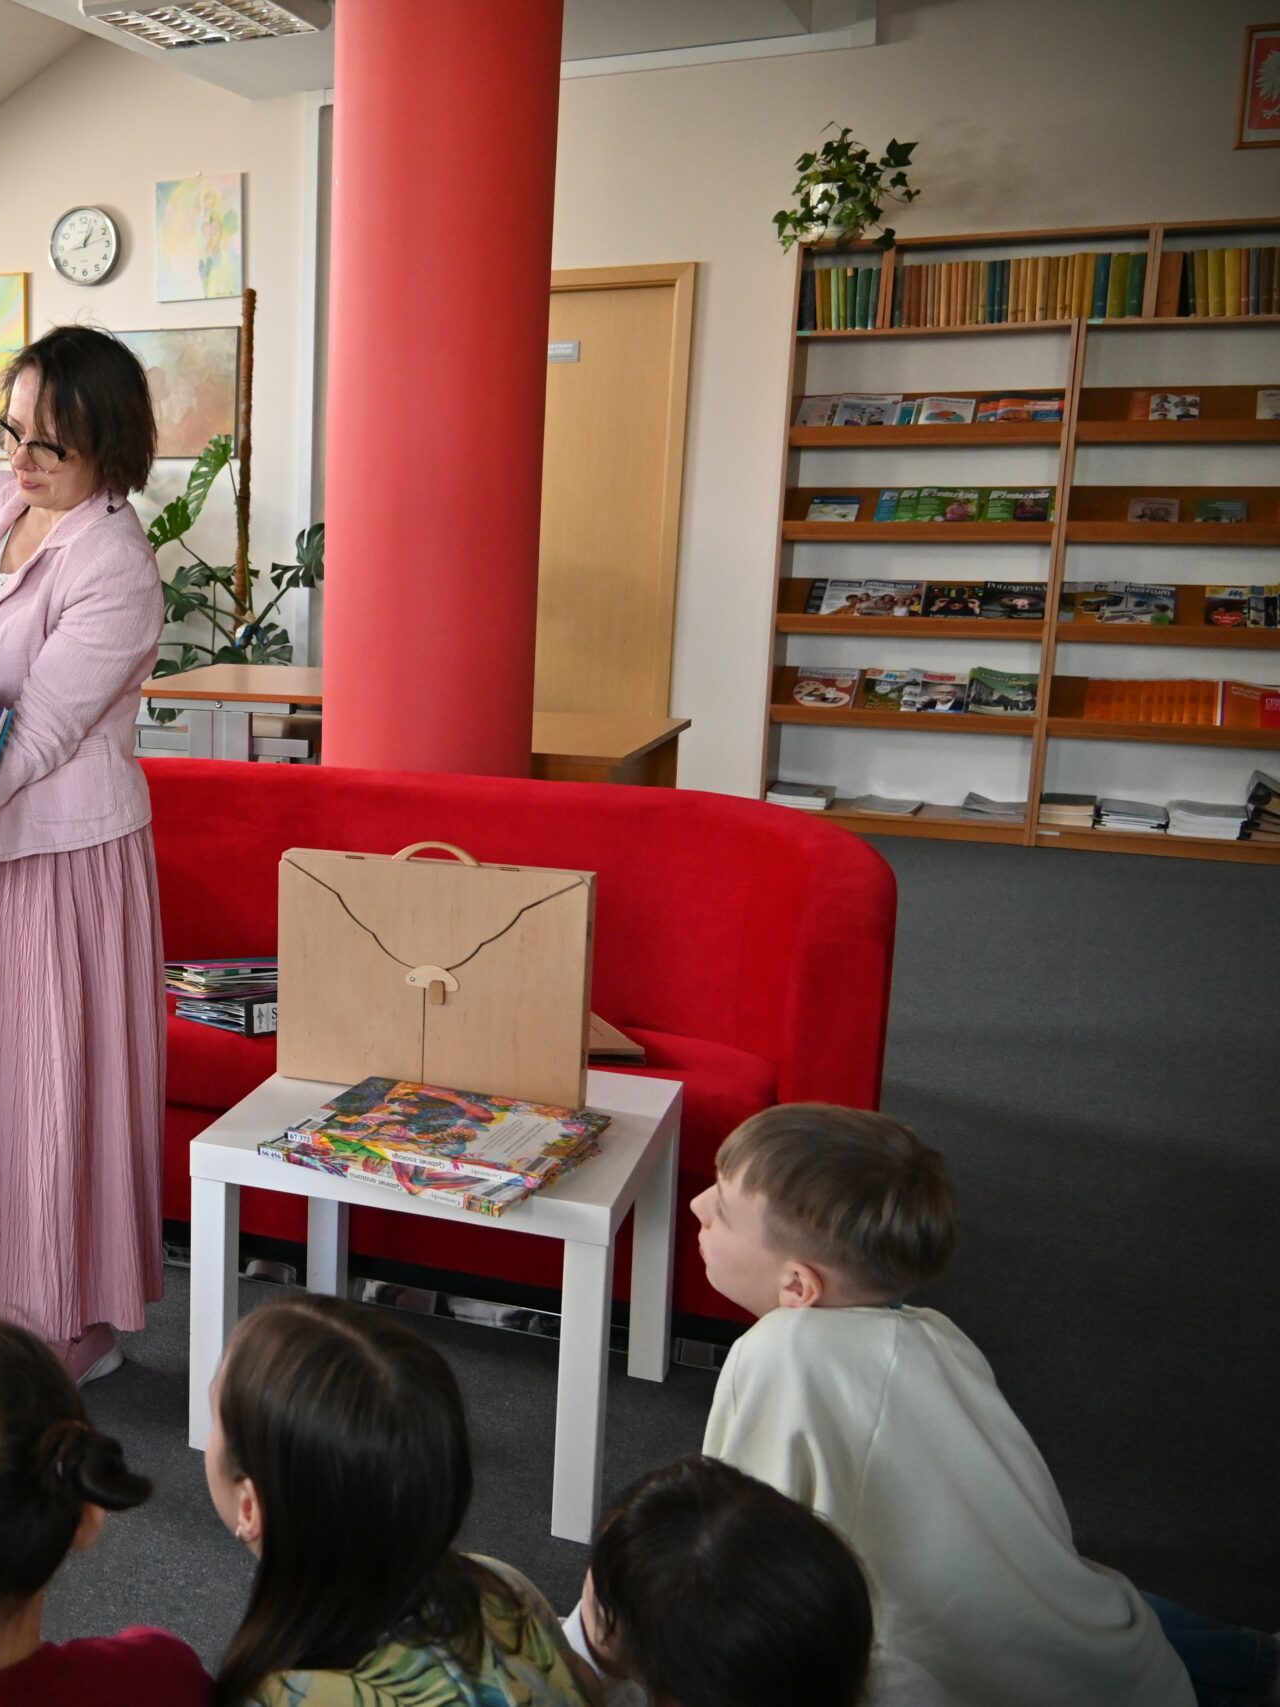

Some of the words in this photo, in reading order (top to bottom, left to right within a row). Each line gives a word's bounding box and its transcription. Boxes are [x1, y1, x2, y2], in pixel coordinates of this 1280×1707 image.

[79, 216, 88, 224] 12
[63, 259, 69, 267] 8
[82, 268, 89, 277] 6
[419, 1159, 446, 1170] Gabinet
[378, 1179, 403, 1192] Gabinet
